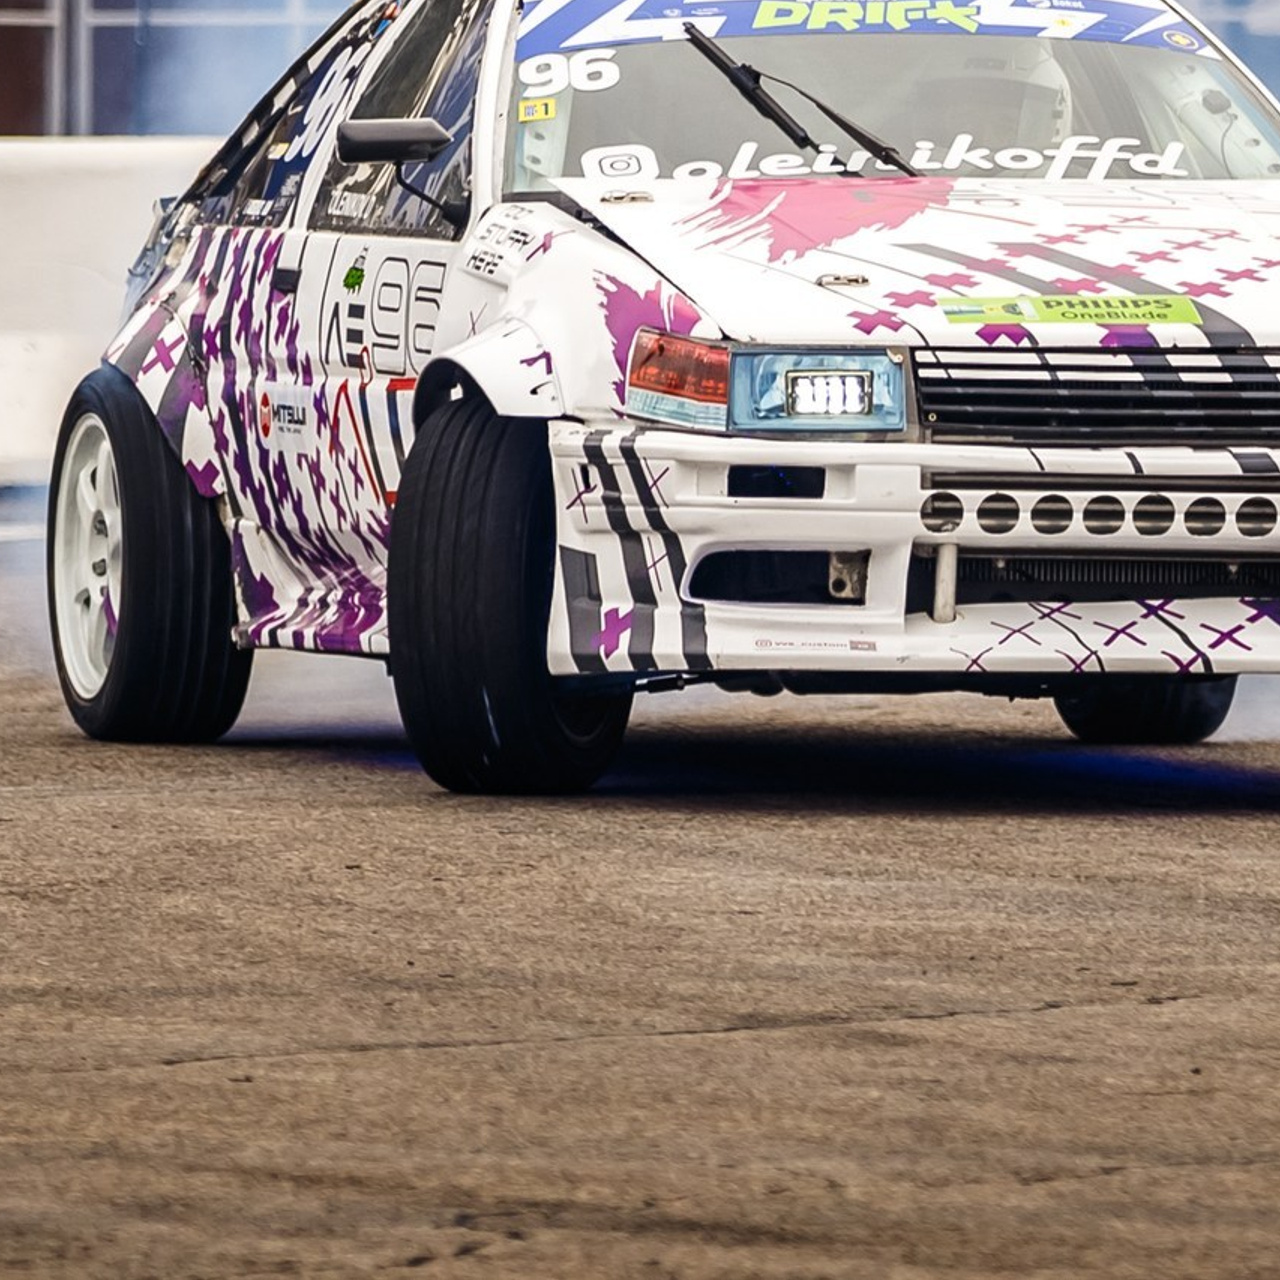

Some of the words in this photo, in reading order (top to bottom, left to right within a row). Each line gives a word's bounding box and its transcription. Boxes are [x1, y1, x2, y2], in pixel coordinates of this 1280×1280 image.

[518, 48, 621, 98] 96
[1042, 298, 1174, 310] PHILIPS
[1060, 311, 1169, 321] OneBlade
